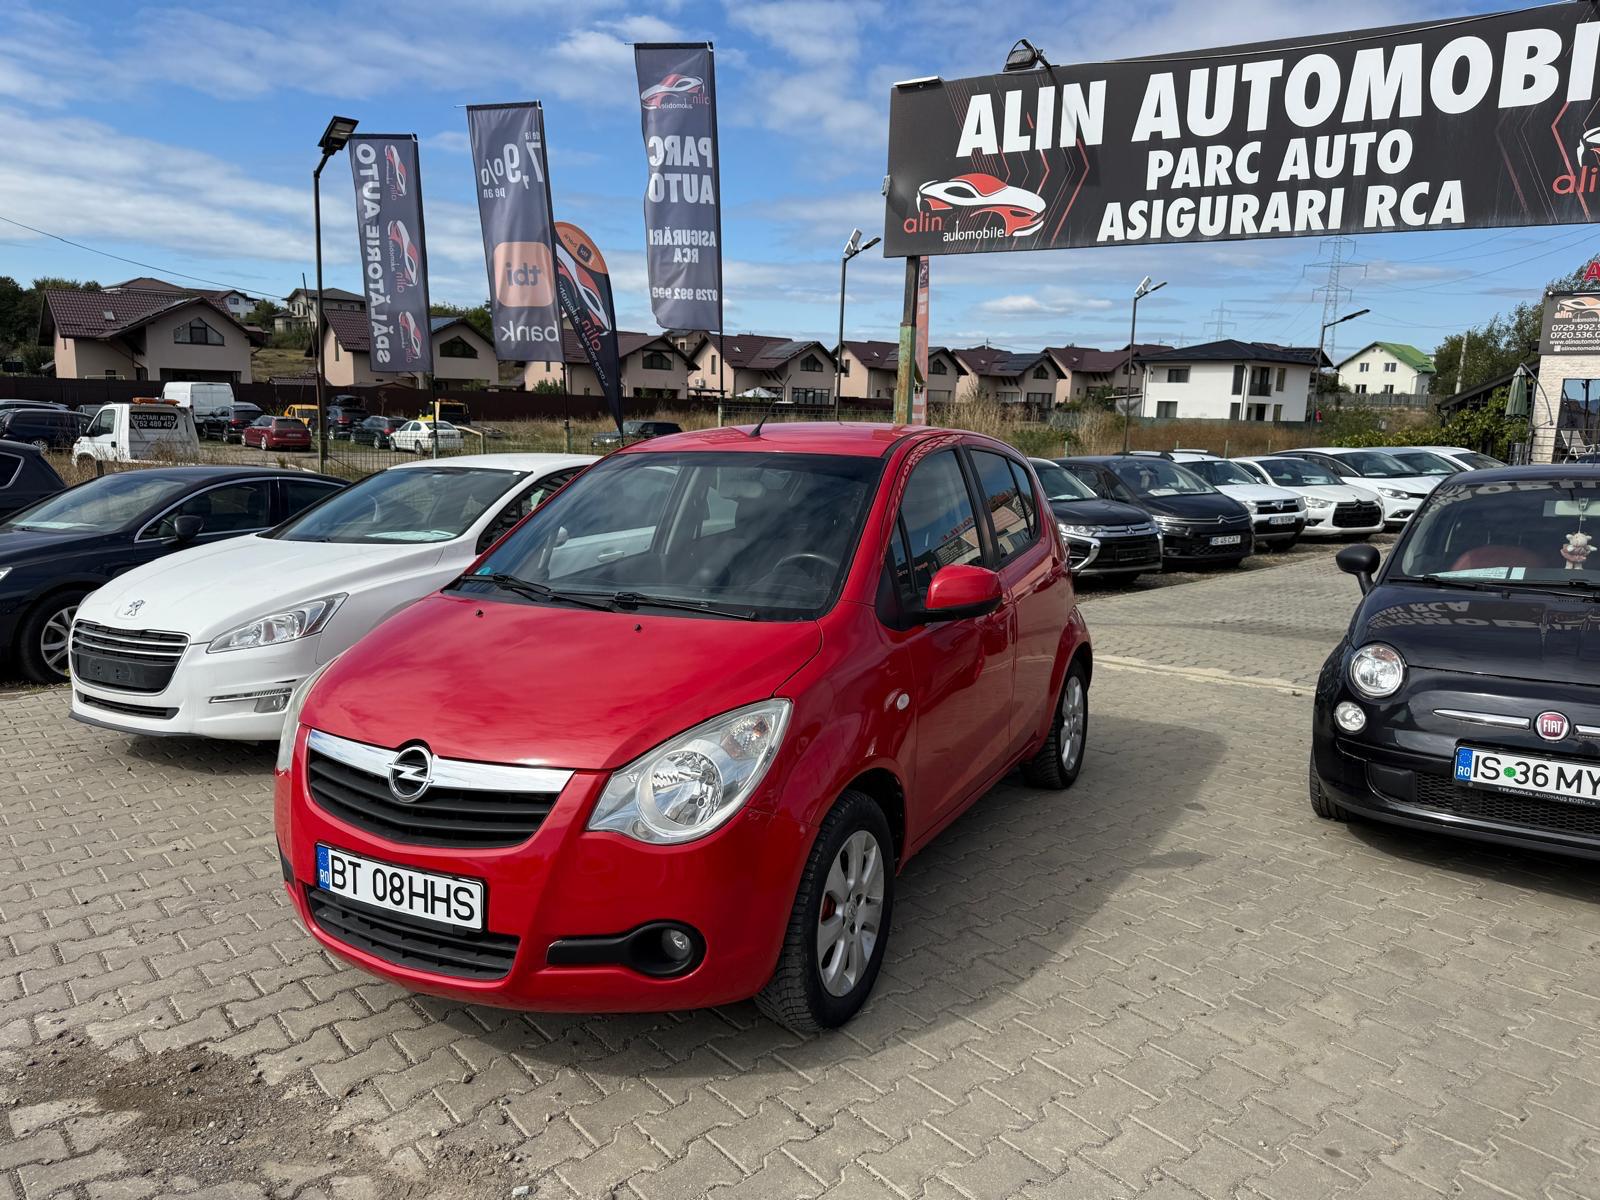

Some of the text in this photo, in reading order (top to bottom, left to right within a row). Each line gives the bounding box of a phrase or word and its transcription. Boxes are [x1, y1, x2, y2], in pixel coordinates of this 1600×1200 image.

[955, 21, 1600, 158] ALIN AUTOMOBI
[1145, 128, 1414, 191] PARC AUTO
[903, 210, 943, 234] alin
[1096, 180, 1466, 243] ASIGURARI RCA
[942, 219, 1005, 242] automobile
[1543, 719, 1563, 734] FIAT
[1457, 766, 1471, 777] RO
[1472, 755, 1501, 780] IS
[1513, 761, 1550, 787] 36
[1534, 791, 1568, 803] AUTOHAUS
[319, 869, 330, 885] RO
[330, 857, 475, 922] BT 08HHS
